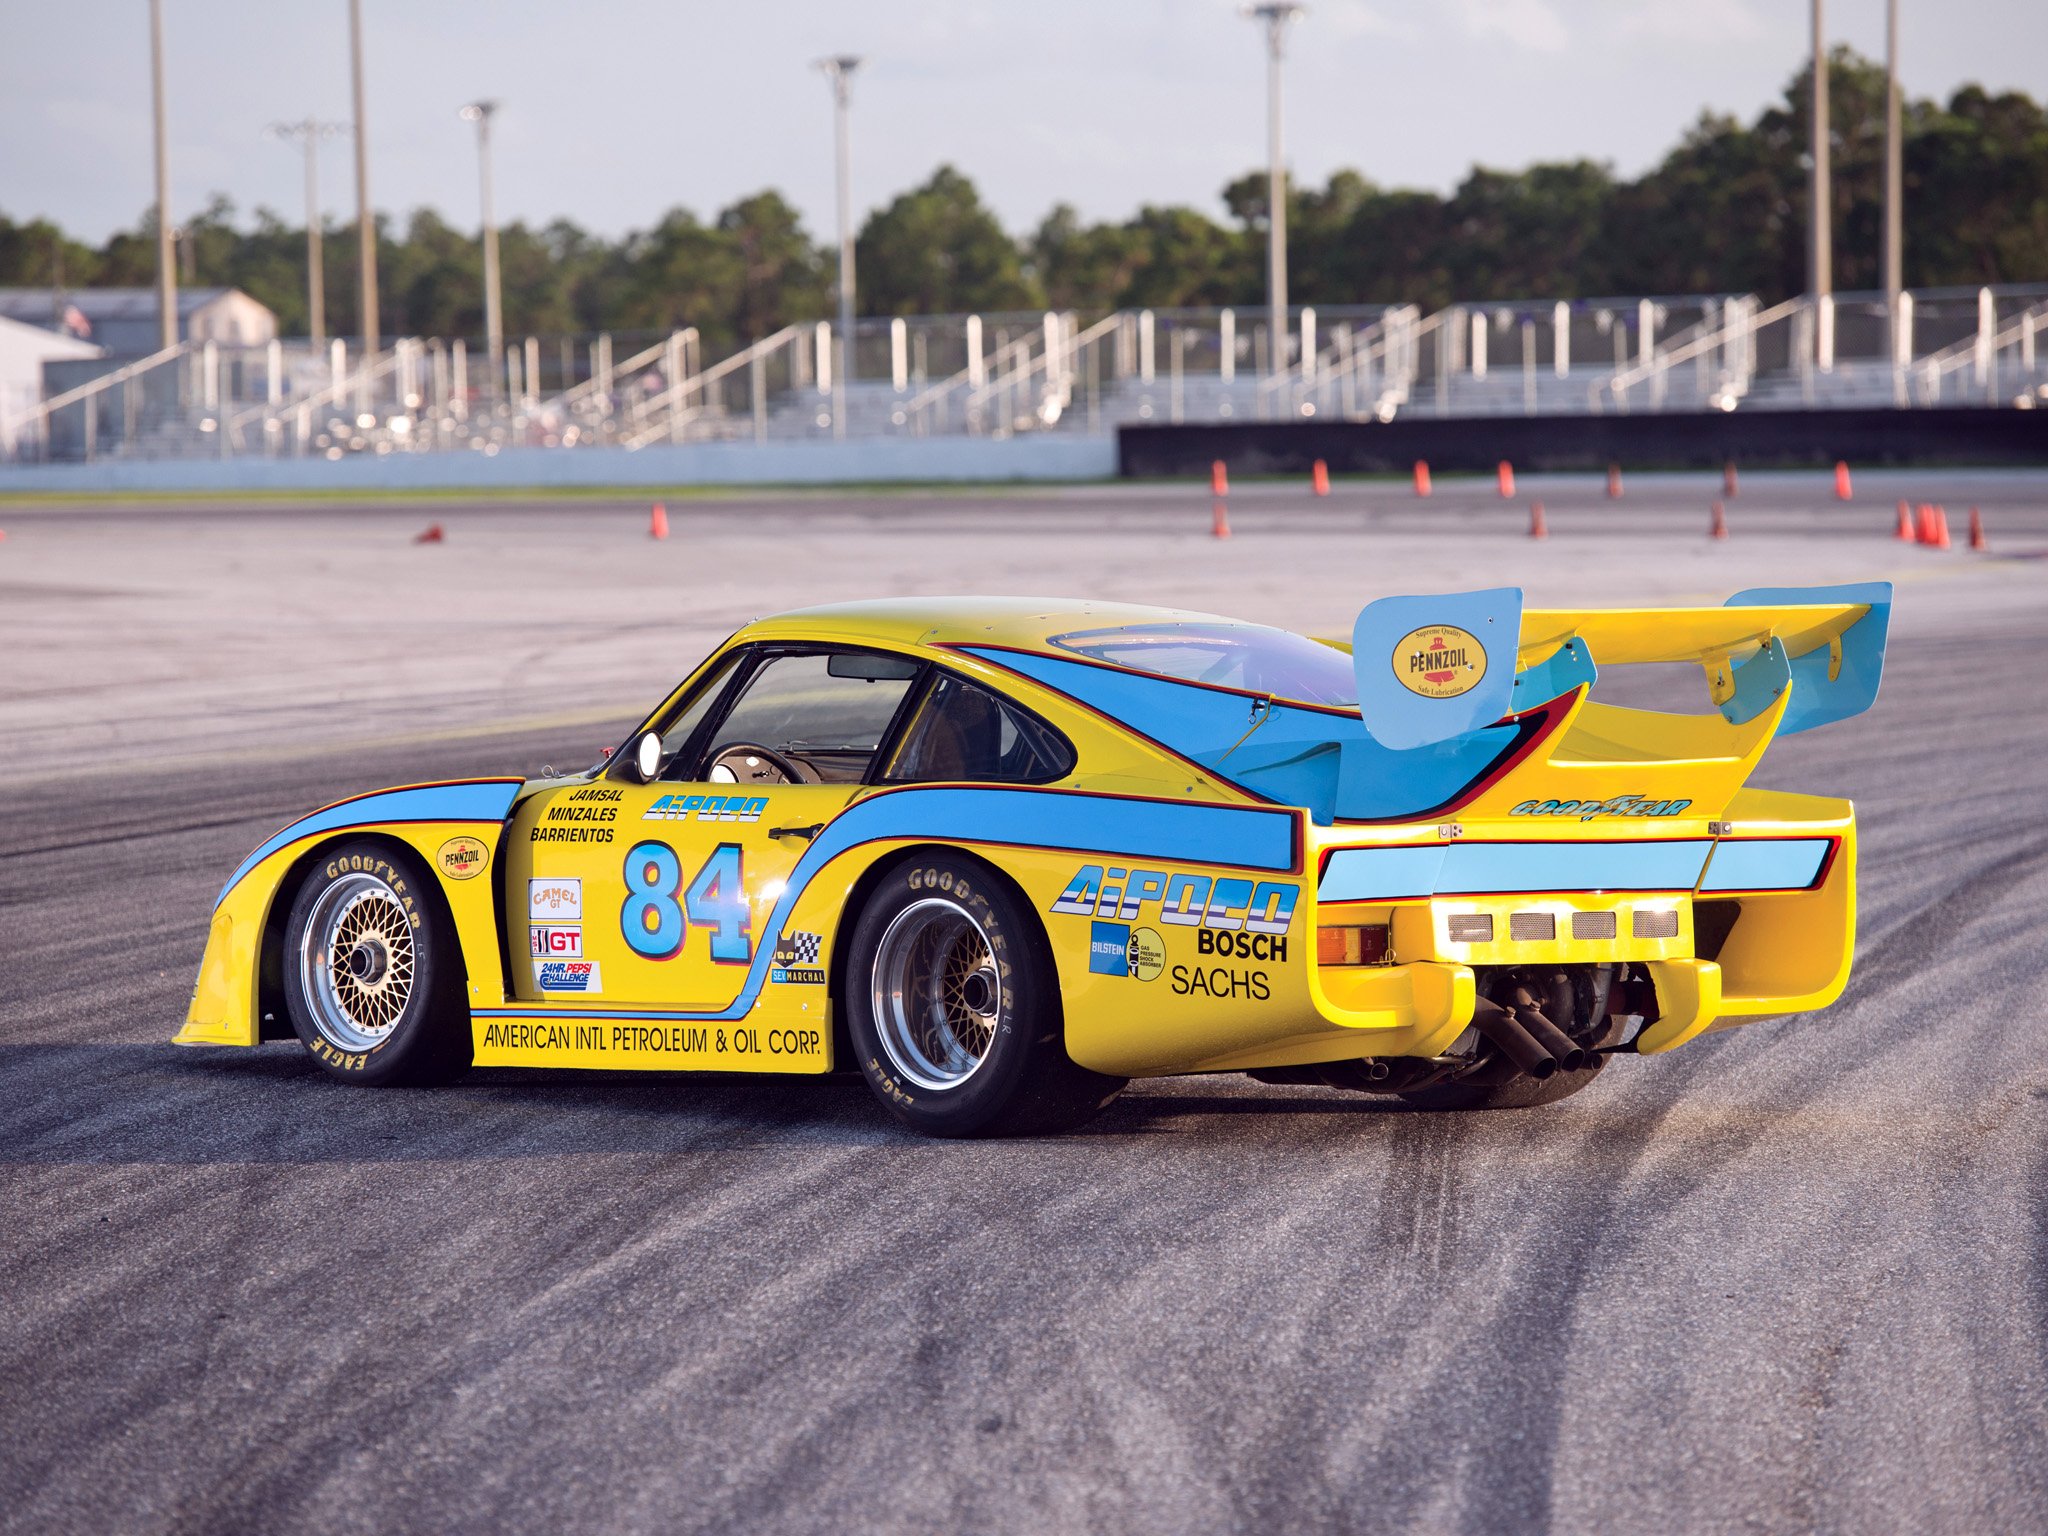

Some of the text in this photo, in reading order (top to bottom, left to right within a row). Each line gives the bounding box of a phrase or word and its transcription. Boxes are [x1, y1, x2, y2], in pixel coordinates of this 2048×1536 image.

[1415, 627, 1462, 639] Supreme Quality
[1410, 648, 1468, 673] PENNZOIL
[1418, 685, 1464, 696] Safe Lubrication
[569, 789, 624, 802] JAMSAL
[548, 807, 617, 822] MINZALES
[1508, 794, 1693, 822] GOODYEAR
[530, 827, 614, 843] BARRIENTOS
[445, 850, 479, 866] PENNZOIL
[326, 855, 420, 930] GOODYEAR
[533, 888, 577, 905] CAMEL
[550, 899, 561, 909] GT
[620, 839, 753, 966] 84
[550, 932, 580, 951] GT
[908, 868, 1014, 1010] GOODYEAR
[1198, 928, 1288, 962] BOSCH
[1091, 941, 1125, 956] BILSTEIN
[566, 963, 592, 974] PEPSI
[787, 971, 824, 982] MARCHAL
[540, 973, 590, 986] CHALLENGE
[1171, 965, 1271, 1001] SACHS
[483, 1024, 821, 1055] AMERICAN INTL PETROLEUM & OIL CORP.
[309, 1036, 368, 1071] EAGLE
[866, 1058, 914, 1109] EAGLE
